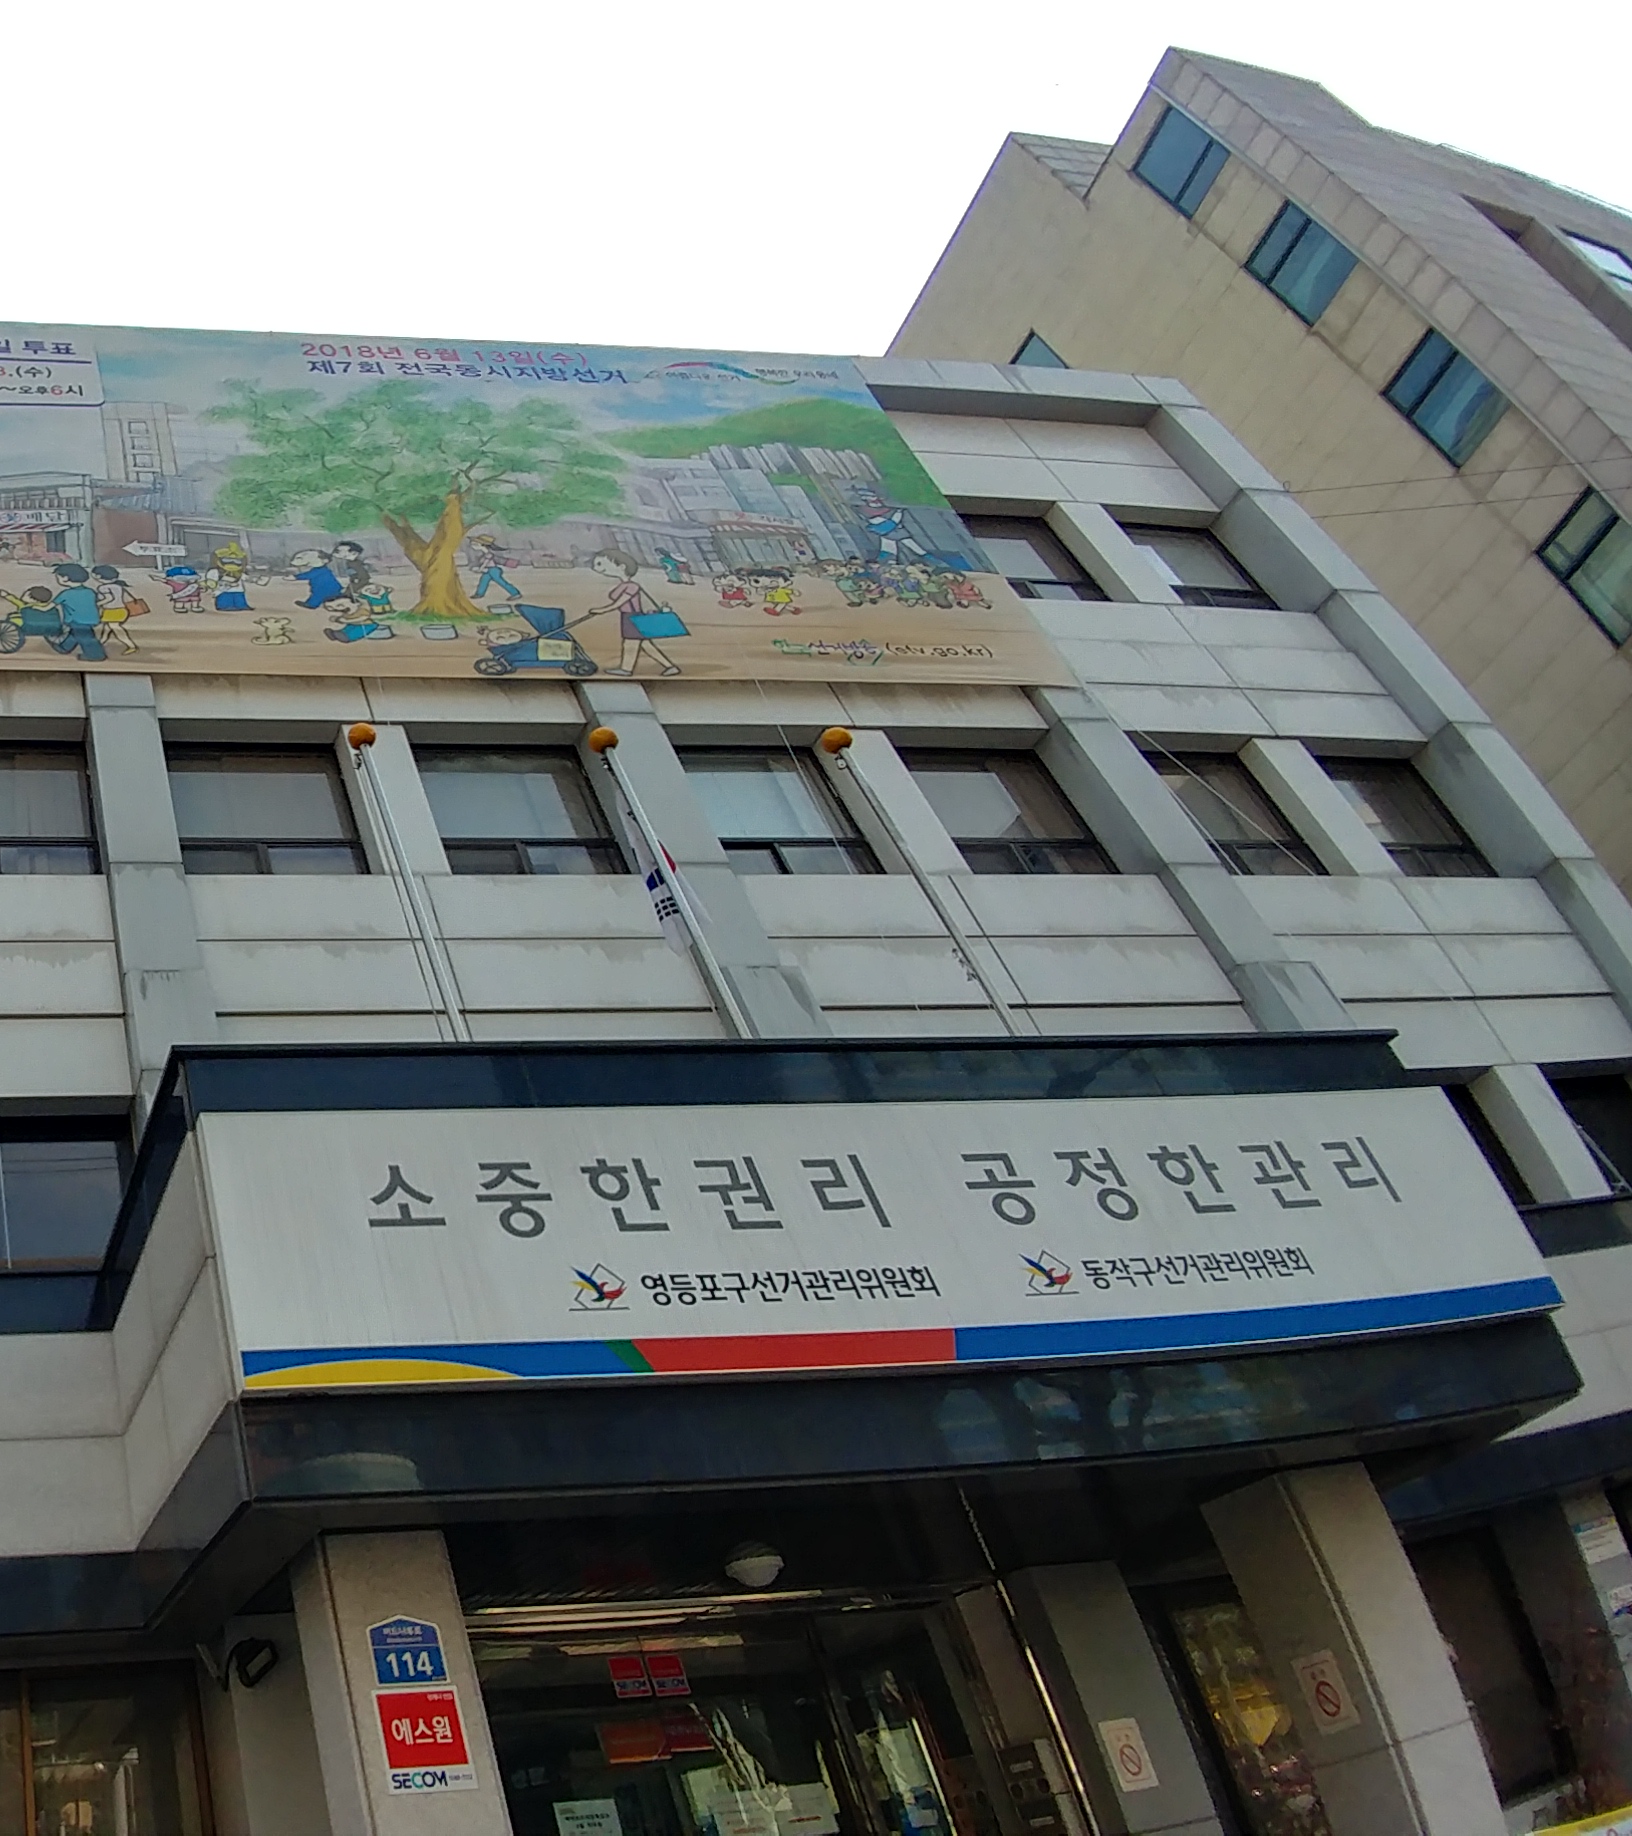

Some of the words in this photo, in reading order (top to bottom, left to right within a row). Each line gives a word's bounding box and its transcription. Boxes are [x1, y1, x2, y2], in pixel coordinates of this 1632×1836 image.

[21, 340, 77, 356] 투표
[301, 342, 405, 360] 2018년
[414, 347, 461, 362] 6월
[473, 350, 587, 368] 13일(수)
[307, 360, 385, 375] 제7회
[395, 362, 628, 384] 전국동시지방선거
[1079, 1246, 1316, 1290] 동작구선거관리위원회
[639, 1264, 941, 1307] 영등포구선거관리위원회
[386, 1651, 434, 1678] 114
[391, 1716, 453, 1745] 에스원
[391, 1769, 448, 1789] SECOM
